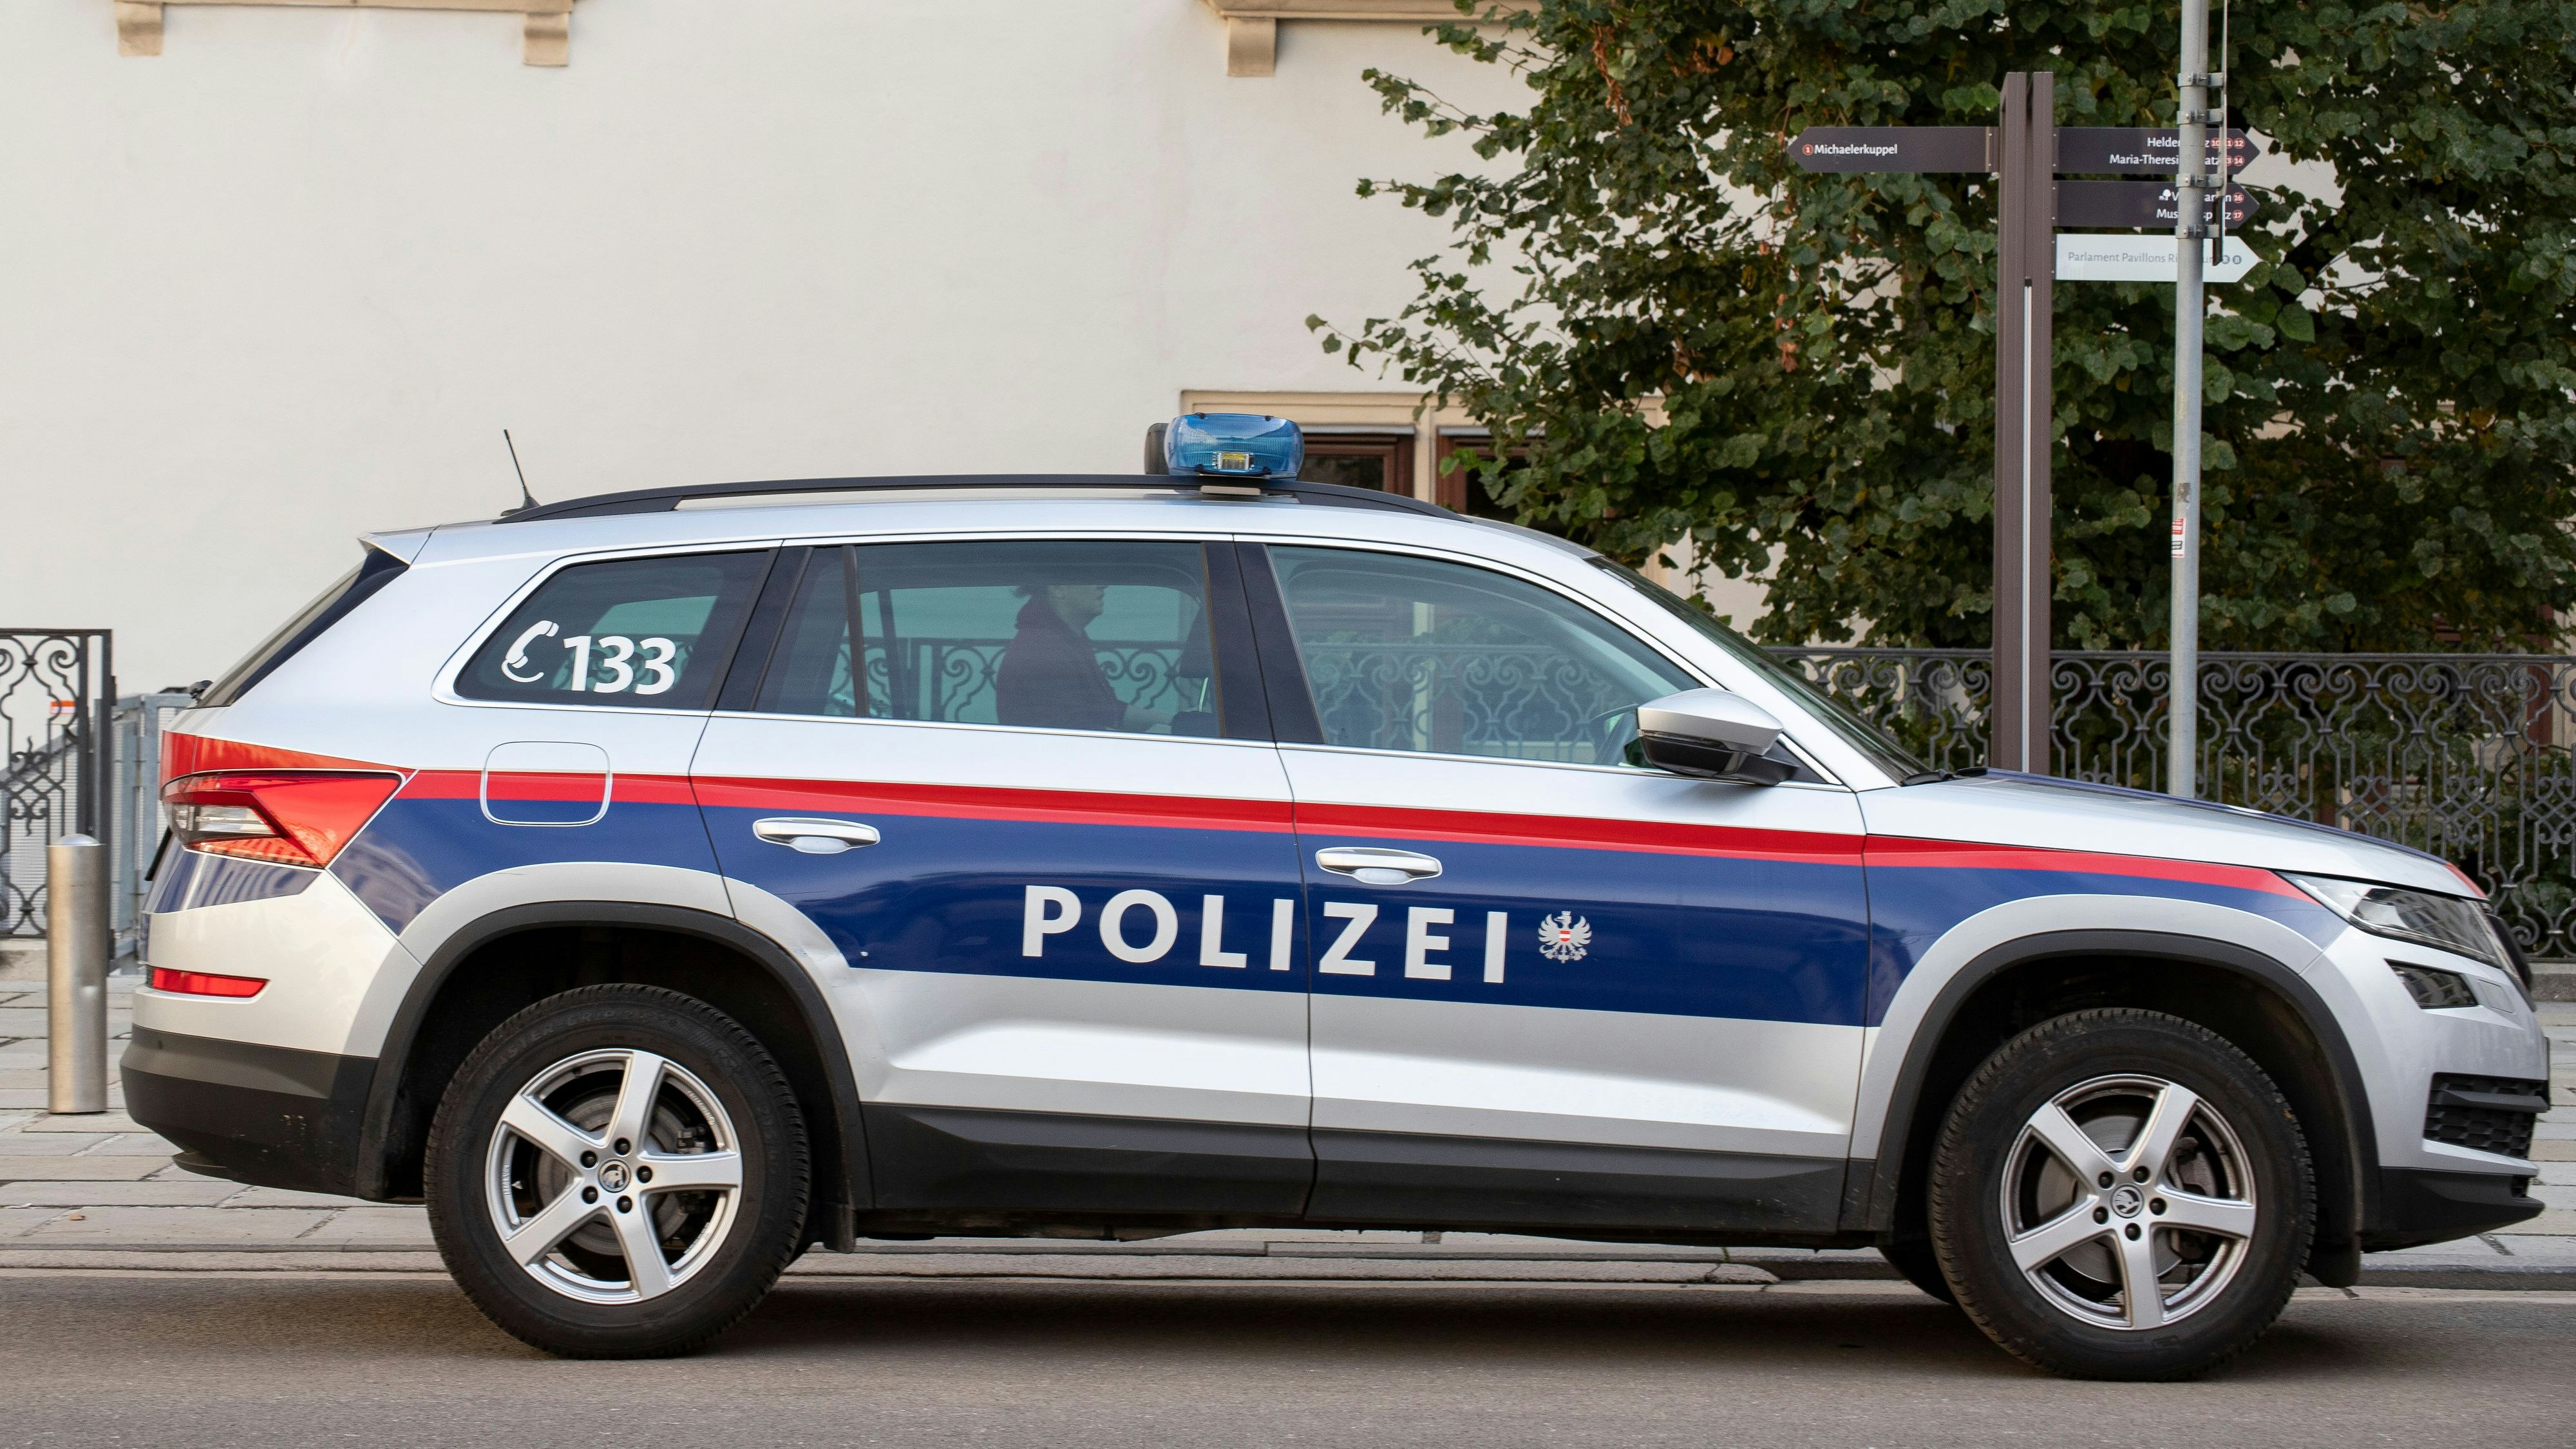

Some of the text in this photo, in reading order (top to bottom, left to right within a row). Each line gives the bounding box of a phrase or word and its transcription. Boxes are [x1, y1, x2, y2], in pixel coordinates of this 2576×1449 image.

[2146, 137, 2210, 147] Heldez
[1814, 144, 1897, 156] Michaelerkuppel
[2109, 154, 2219, 166] Maria-Theresiatz
[2068, 252, 2119, 262] Parlament
[2122, 253, 2166, 263] Pavillons
[563, 636, 677, 695] 133
[1022, 885, 1508, 983] POLIZEI
